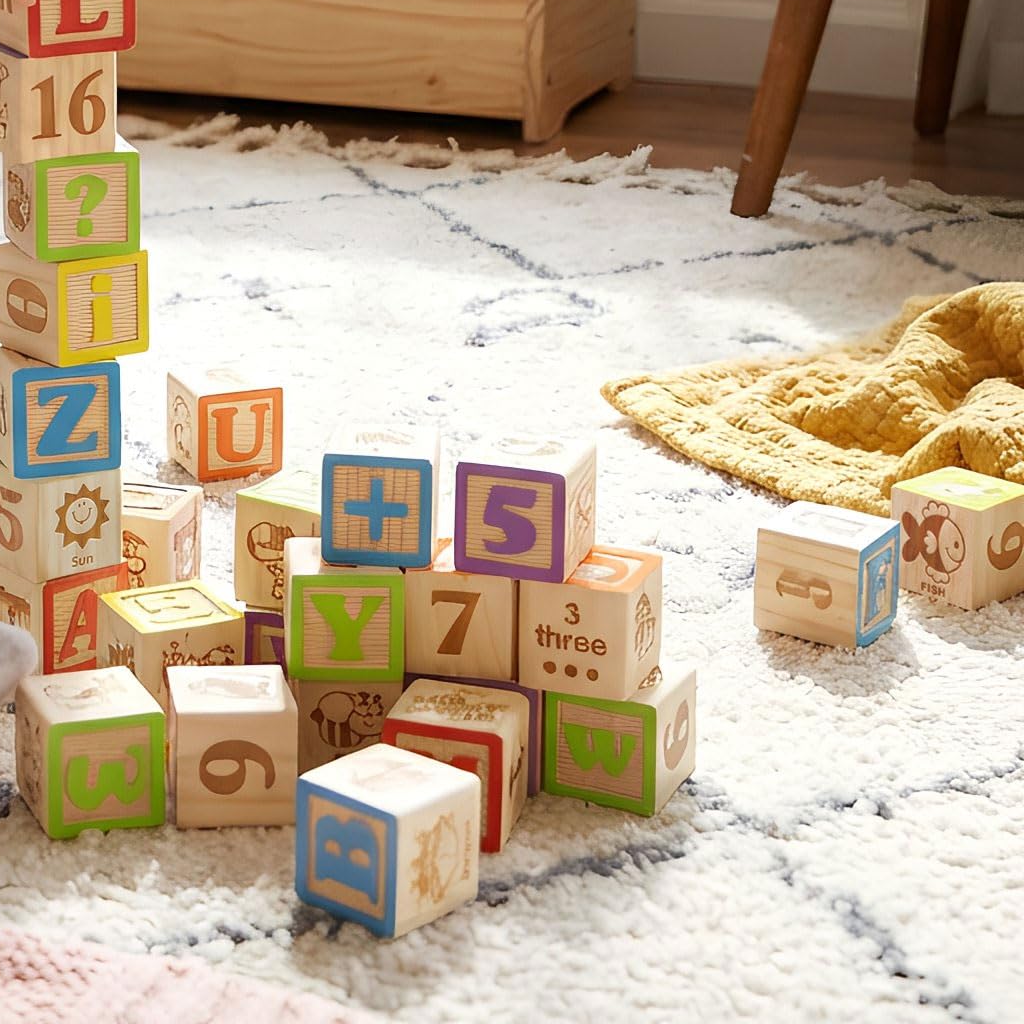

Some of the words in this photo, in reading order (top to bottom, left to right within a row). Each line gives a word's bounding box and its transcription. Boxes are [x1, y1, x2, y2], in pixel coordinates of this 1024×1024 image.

[31, 69, 106, 140] 16
[64, 173, 109, 238] ?
[36, 383, 99, 457] Z
[211, 402, 271, 463] U
[481, 484, 538, 555] 5
[71, 554, 94, 568] Sun
[920, 581, 946, 598] FISH
[58, 588, 97, 663] A
[309, 593, 386, 661] Y
[431, 590, 481, 656] 7
[534, 623, 608, 657] three
[564, 602, 581, 625] 3
[314, 815, 380, 906] B
